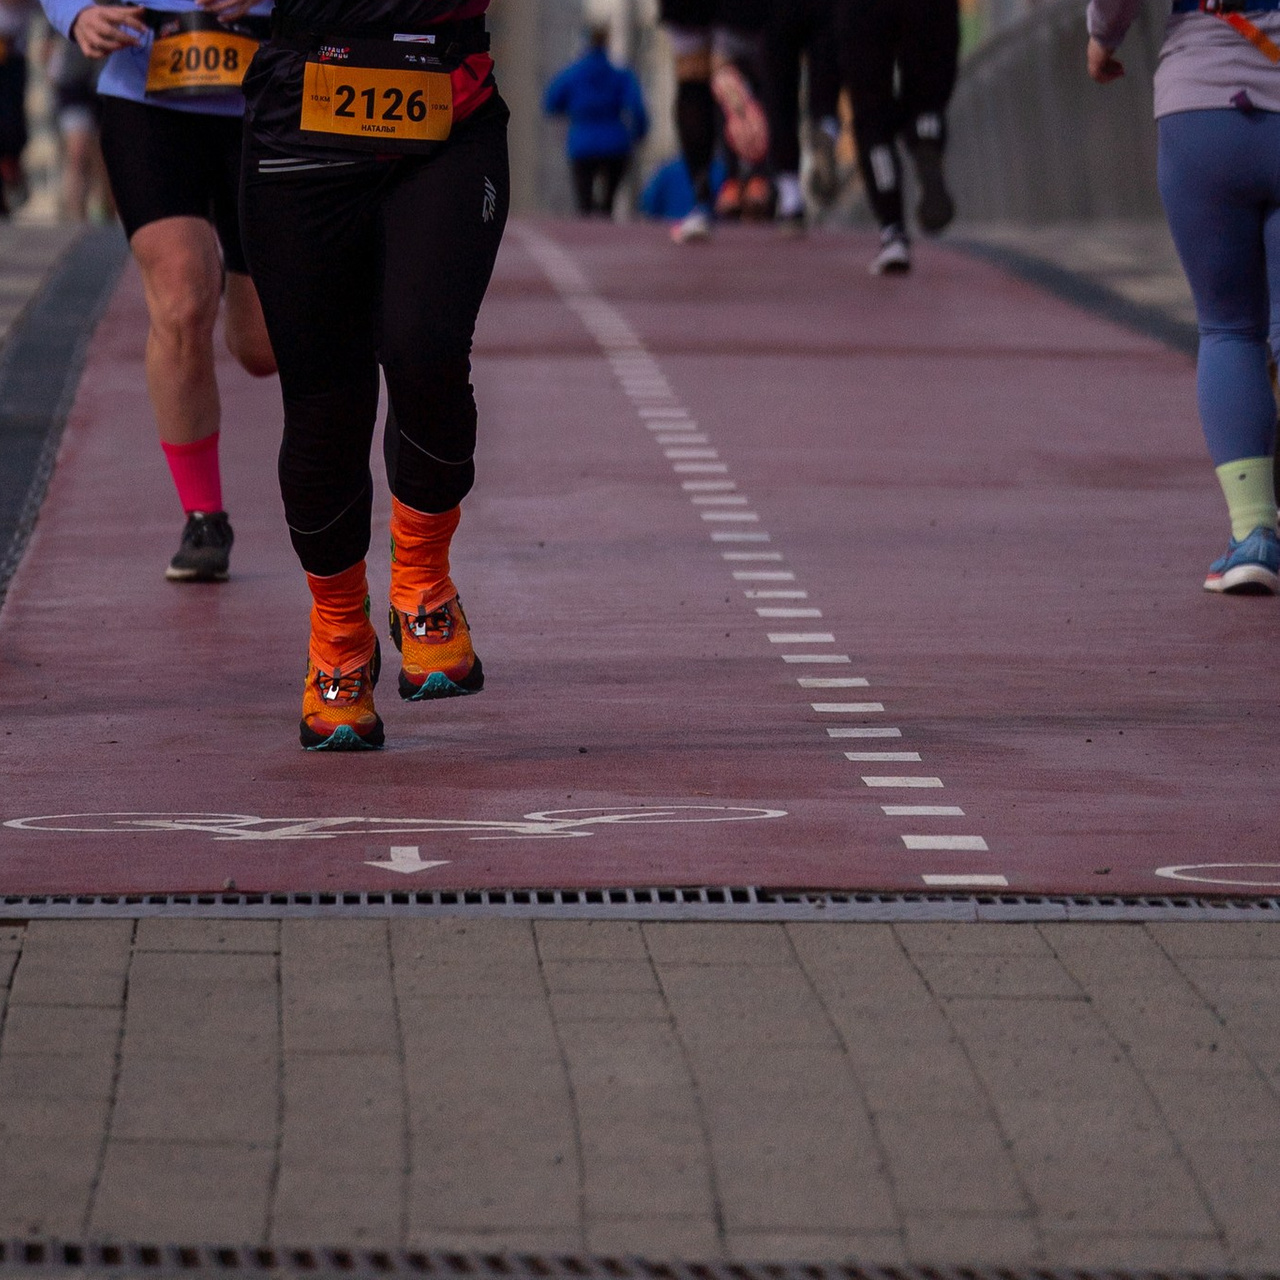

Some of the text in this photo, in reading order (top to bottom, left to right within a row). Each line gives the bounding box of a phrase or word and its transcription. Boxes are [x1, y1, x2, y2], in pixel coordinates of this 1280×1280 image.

[170, 46, 238, 74] 2008
[335, 85, 427, 122] 2126
[361, 124, 396, 133] НАТАЛЬЯ
